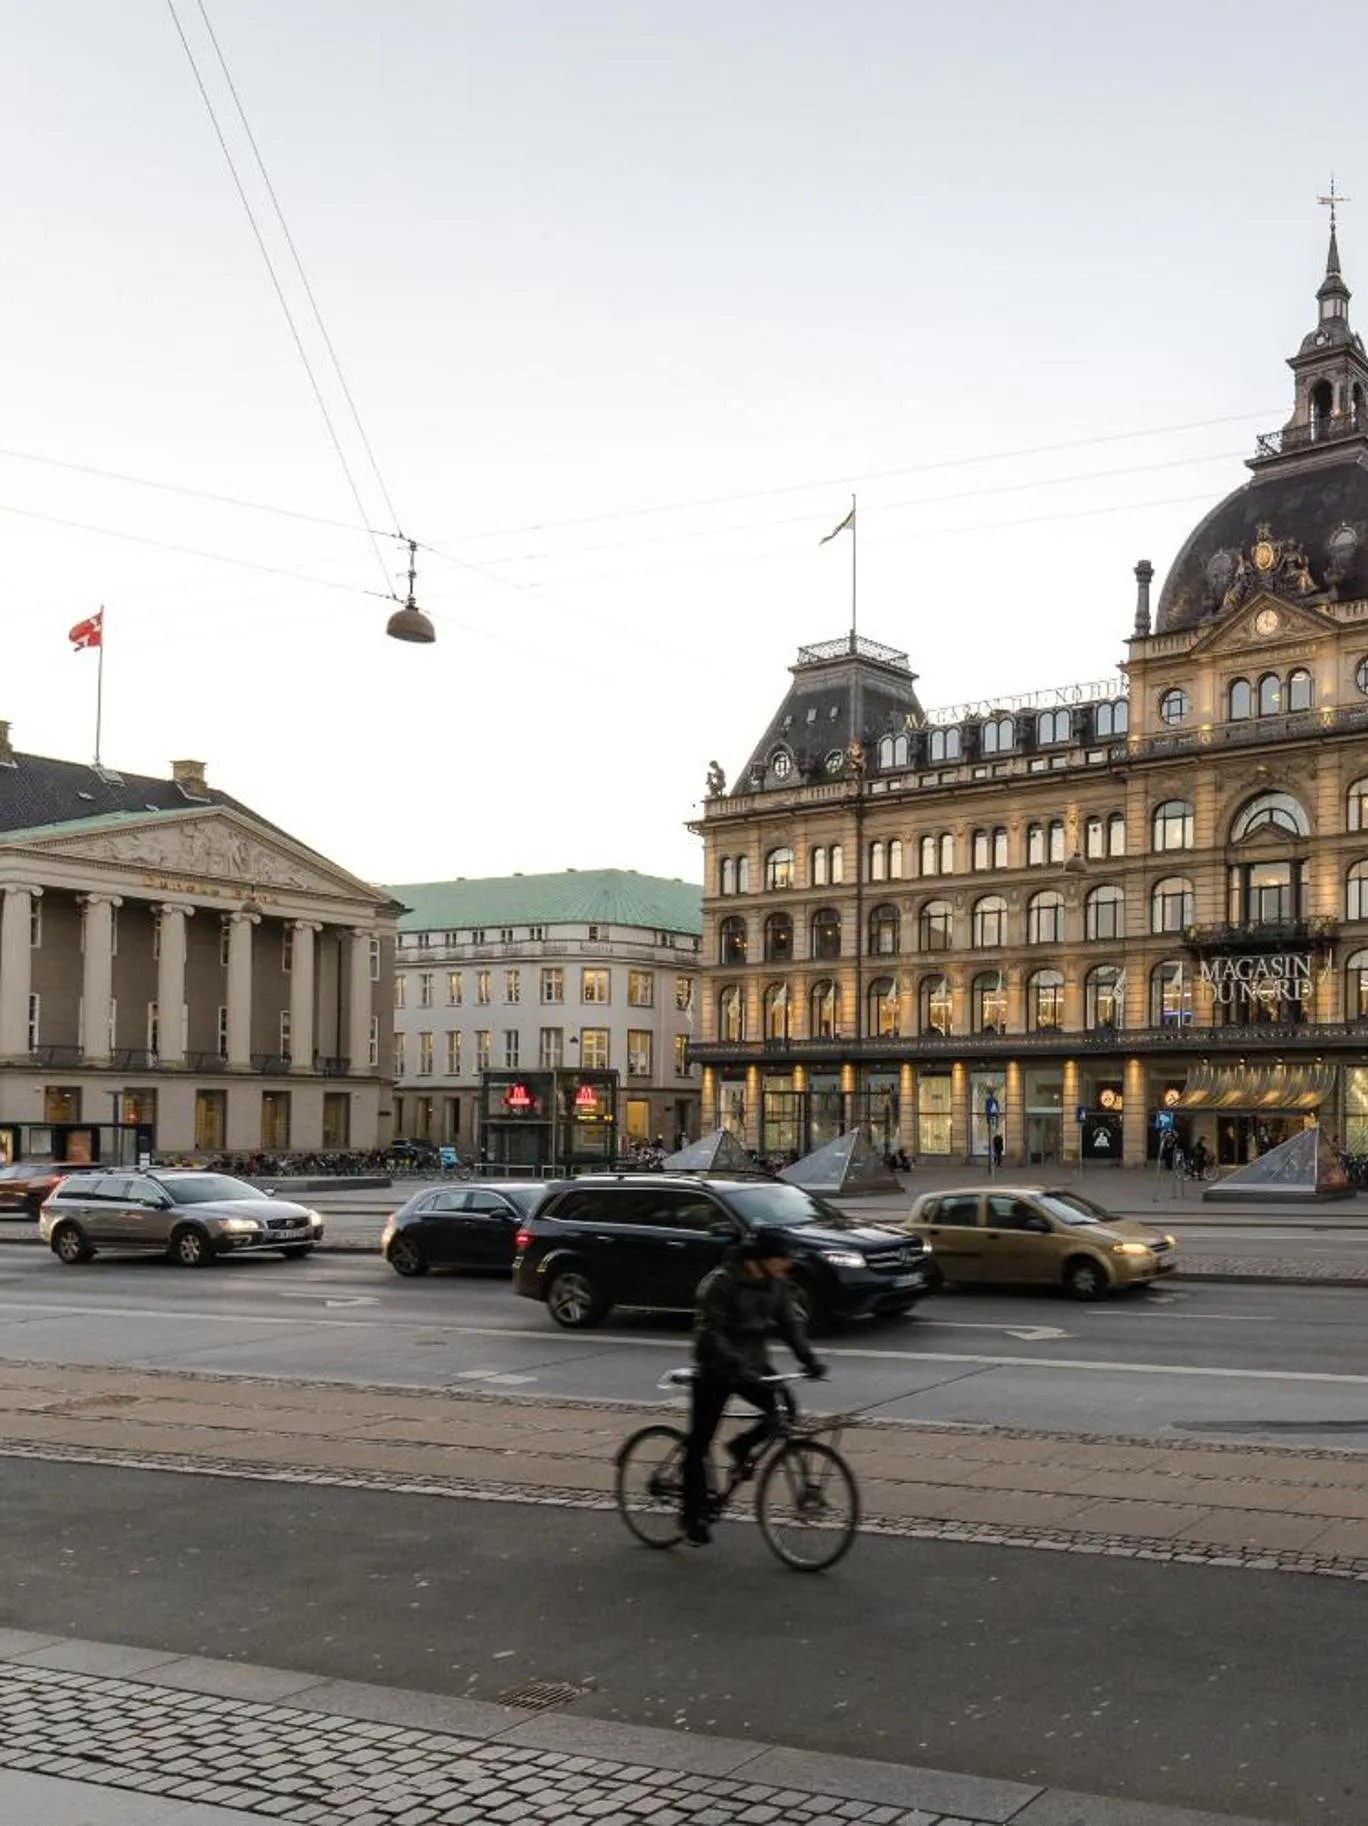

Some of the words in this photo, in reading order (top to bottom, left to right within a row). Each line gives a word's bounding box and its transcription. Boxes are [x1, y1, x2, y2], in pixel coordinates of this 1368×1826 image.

[1200, 955, 1312, 982] MAGASIN
[1202, 979, 1236, 1004] DU
[1240, 979, 1315, 1003] NORD
